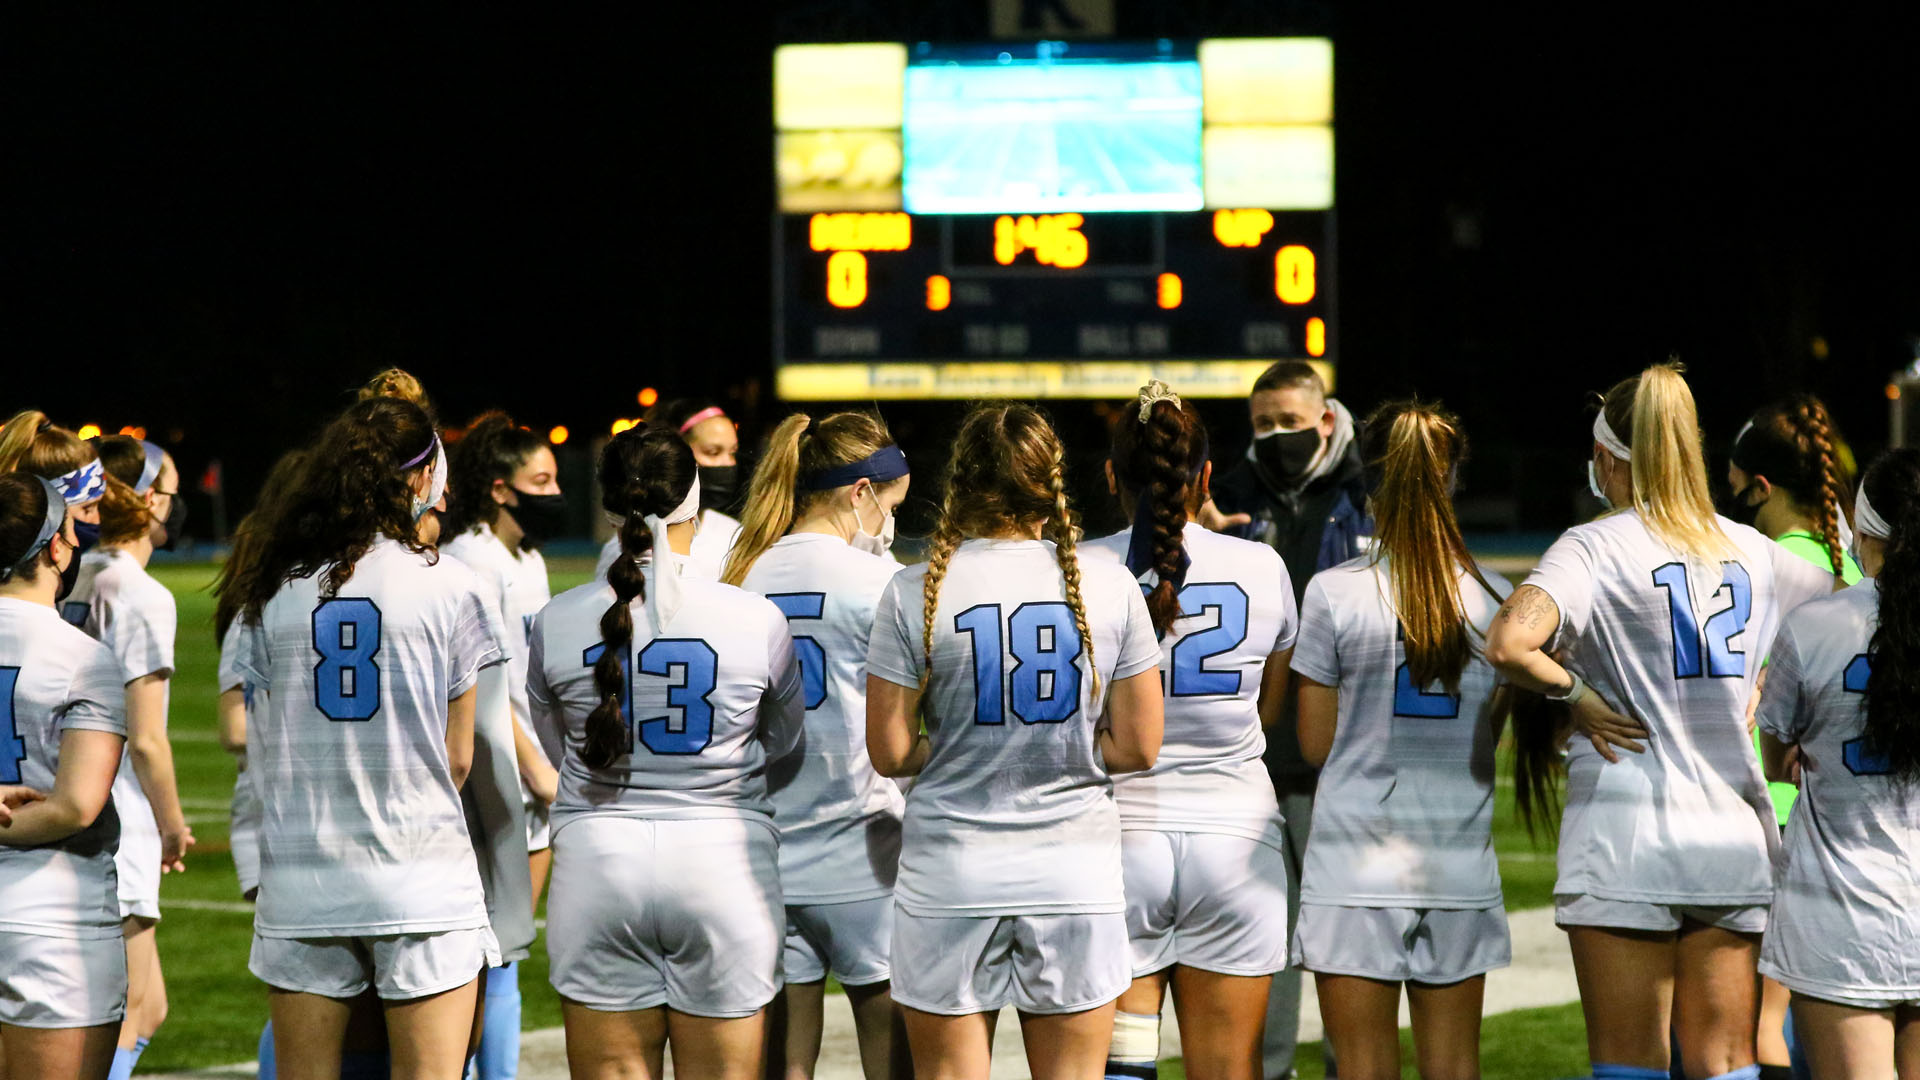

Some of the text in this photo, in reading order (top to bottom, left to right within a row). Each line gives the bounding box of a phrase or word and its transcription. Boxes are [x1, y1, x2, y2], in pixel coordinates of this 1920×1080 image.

[827, 250, 868, 308] 0
[1275, 245, 1316, 305] 0
[312, 597, 381, 721] 8
[955, 601, 1083, 725] 18
[1651, 561, 1752, 680] 12
[582, 638, 718, 756] 13
